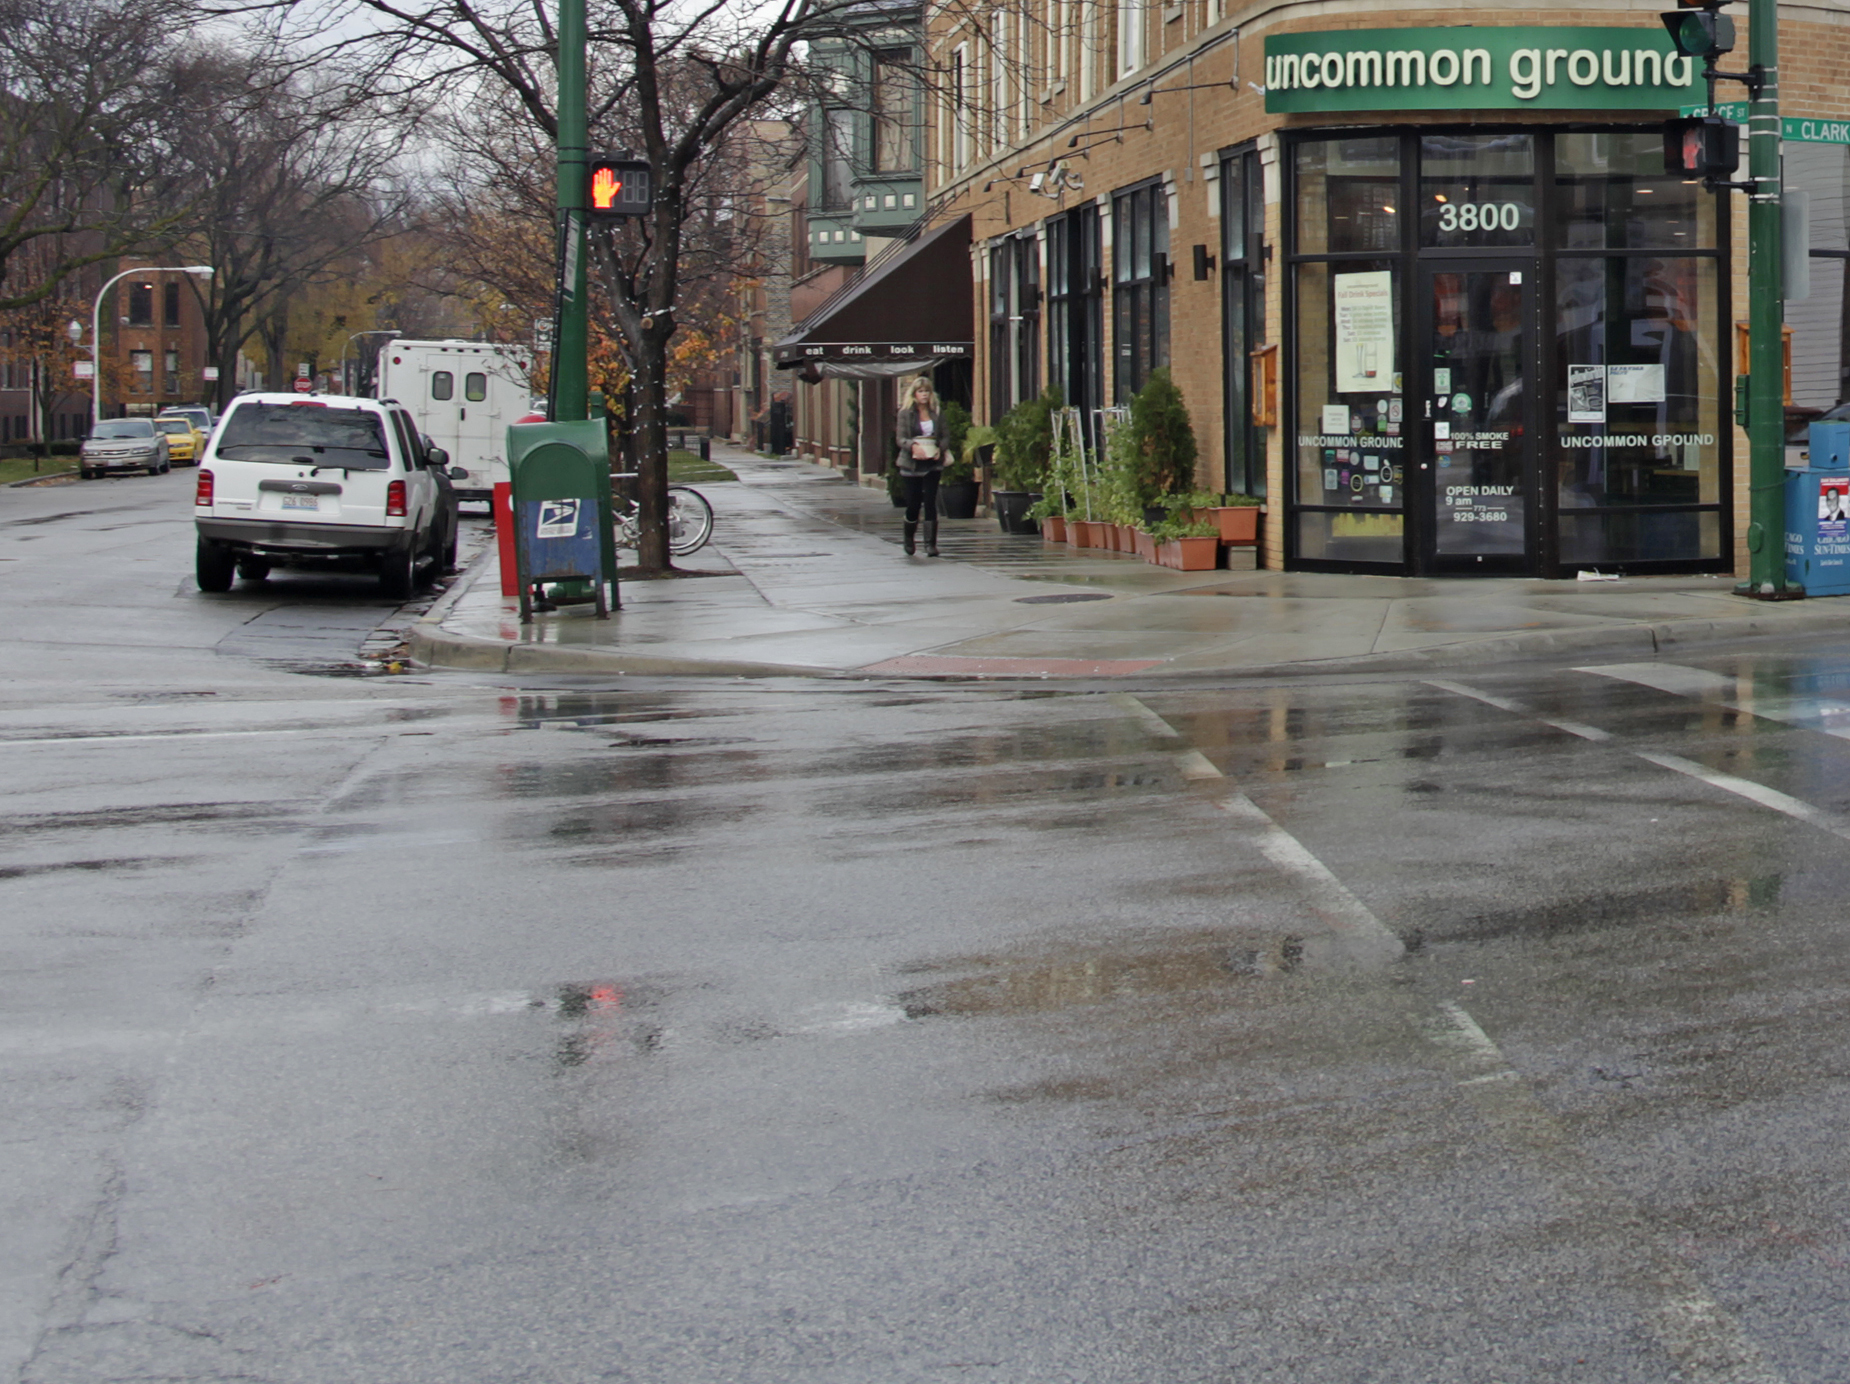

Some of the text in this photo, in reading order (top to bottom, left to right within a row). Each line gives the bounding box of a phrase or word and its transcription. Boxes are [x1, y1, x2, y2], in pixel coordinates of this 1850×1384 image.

[1266, 49, 1491, 91] uncommon
[1737, 108, 1746, 118] ST
[1786, 124, 1792, 134] N
[1801, 122, 1850, 141] CLARK
[1439, 203, 1519, 231] 3800
[806, 344, 964, 355] eat drink look listen
[1450, 432, 1509, 440] 100% SMOKE
[1298, 436, 1357, 447] UNCOMMON
[1456, 441, 1502, 449] FREE
[1561, 435, 1648, 448] UNCOMMON
[1446, 486, 1514, 496] OPEN DAILY
[1446, 496, 1472, 506] 9 am
[1454, 512, 1508, 522] 929-3680
